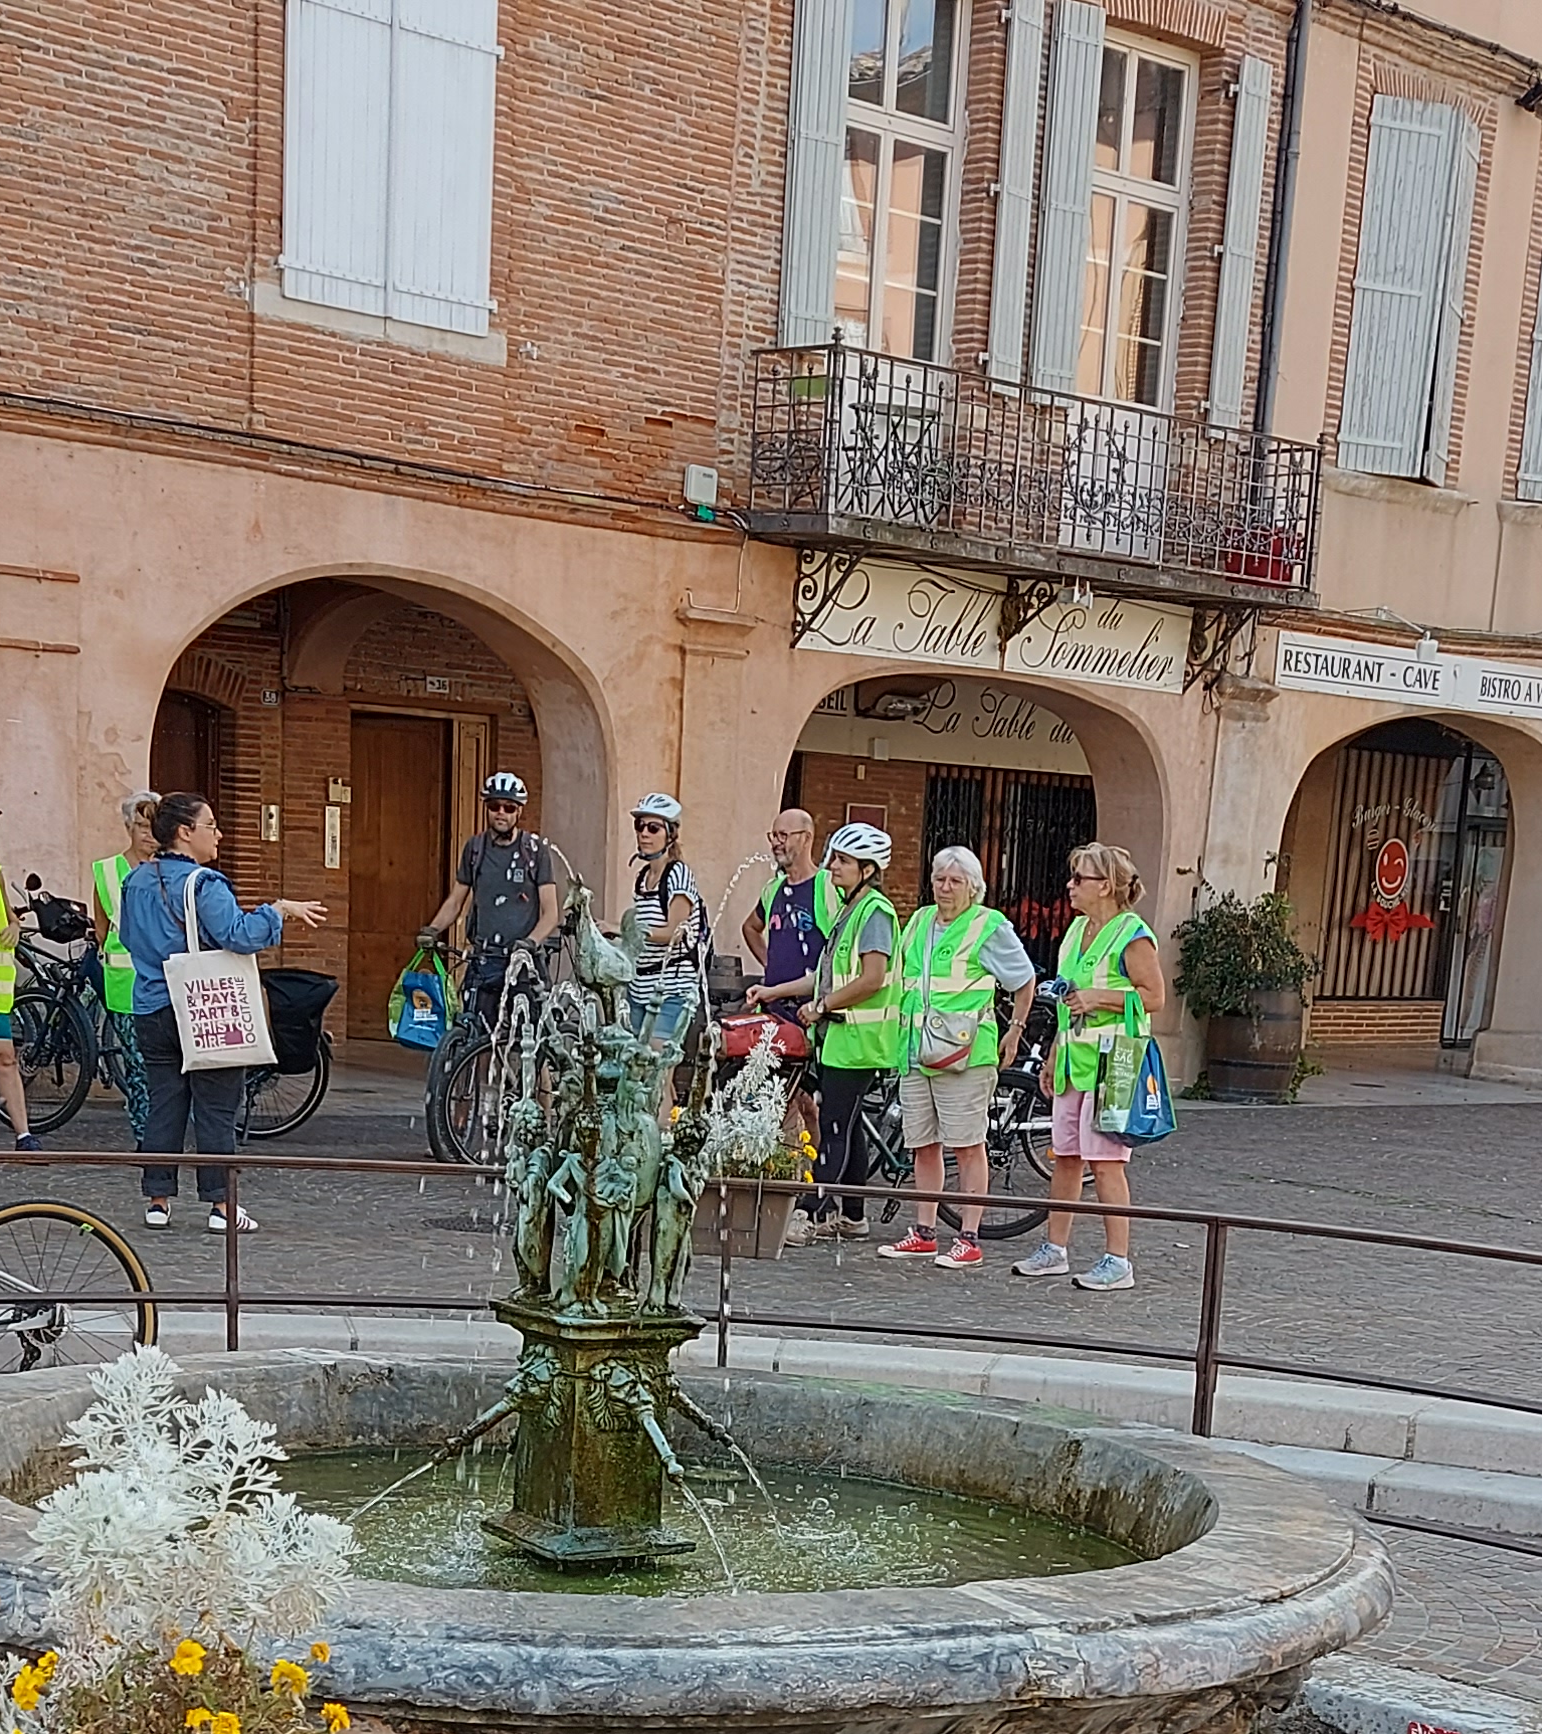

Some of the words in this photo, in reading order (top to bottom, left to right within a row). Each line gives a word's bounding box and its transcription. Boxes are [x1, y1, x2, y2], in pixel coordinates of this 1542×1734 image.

[806, 568, 877, 646] La
[892, 578, 997, 657] Table
[1097, 599, 1125, 630] du
[1020, 608, 1174, 682] Sommelier
[1283, 649, 1384, 683] RESTAURANT
[1402, 666, 1441, 690] CAVE
[1480, 676, 1521, 701] BISTRO
[1524, 682, 1532, 702] A
[913, 679, 961, 734] La
[972, 687, 1036, 741] Table
[184, 976, 234, 994] VILLES
[201, 991, 237, 1006] PAYS
[234, 976, 257, 1044] OCCITANIE
